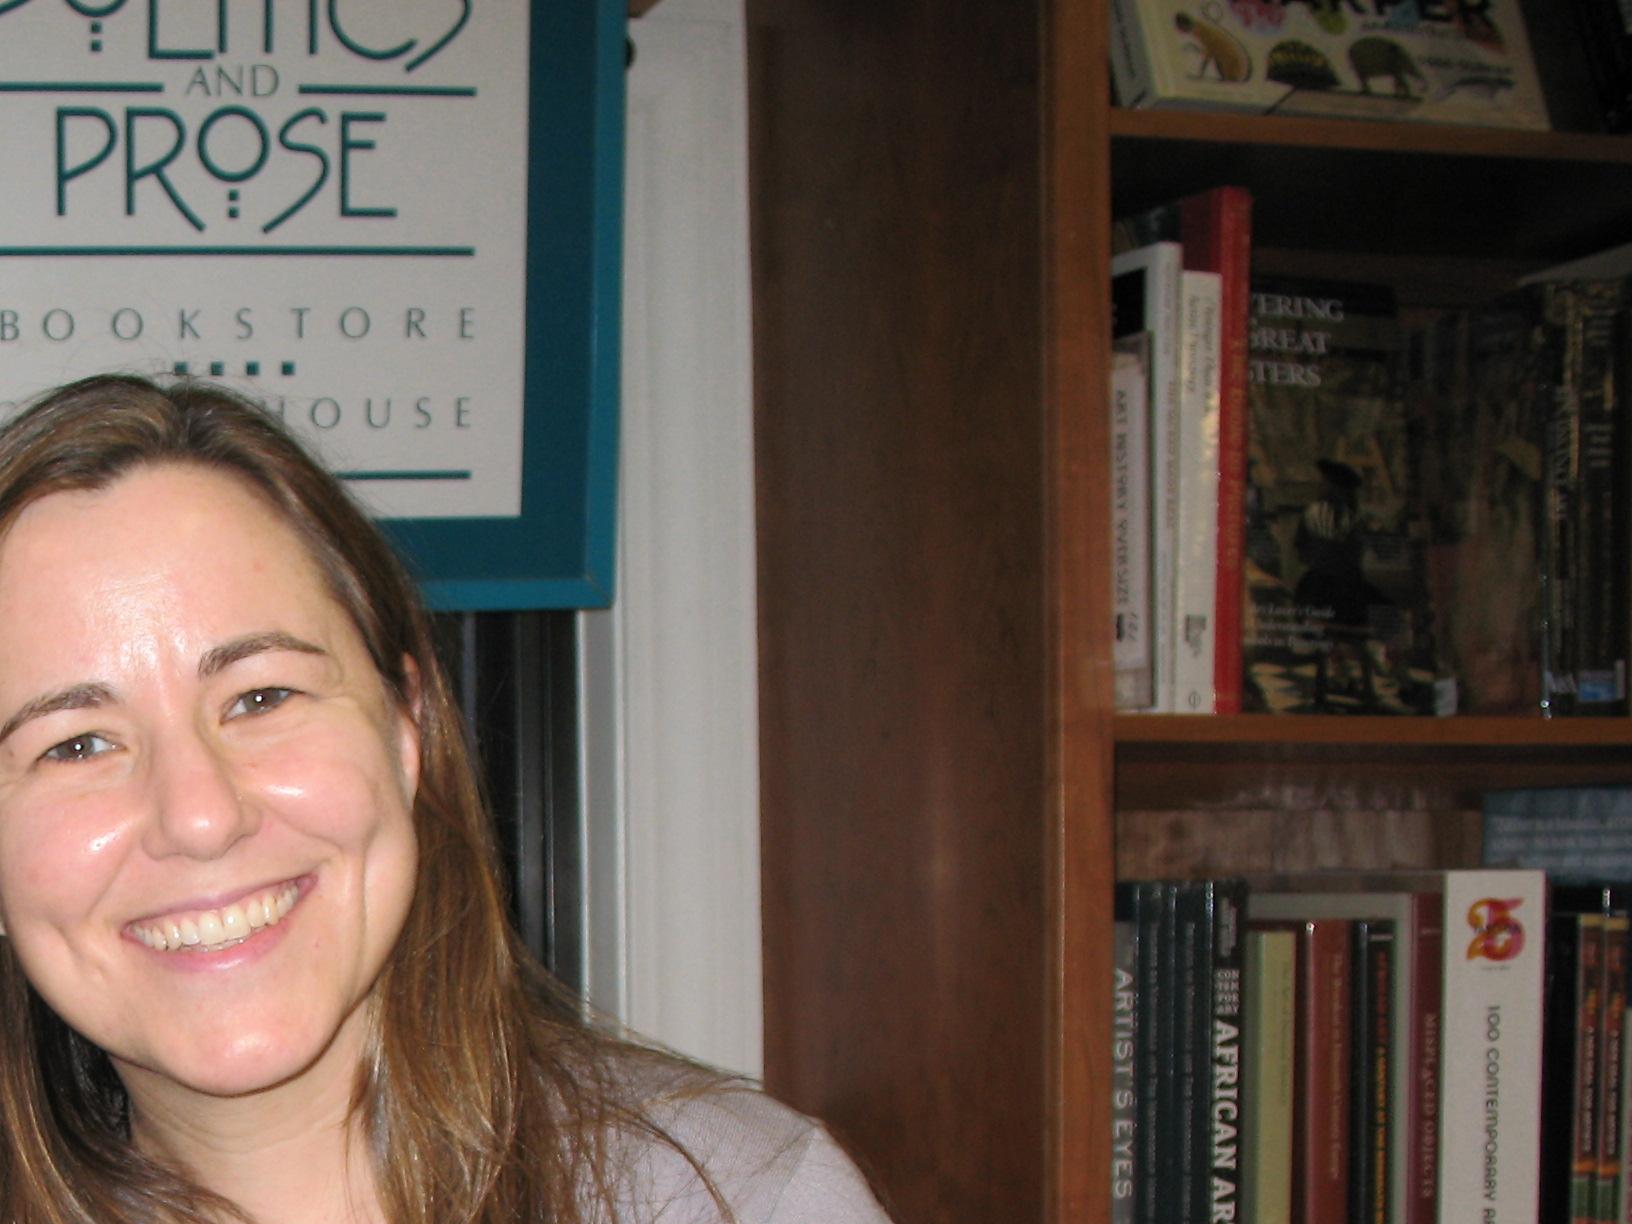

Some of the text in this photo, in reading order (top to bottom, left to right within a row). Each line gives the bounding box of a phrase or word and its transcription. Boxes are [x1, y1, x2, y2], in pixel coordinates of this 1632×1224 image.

[184, 63, 280, 99] AND
[56, 105, 399, 234] PROSE
[1112, 967, 1135, 1199] ARTIST'S EYES
[1486, 1005, 1501, 1042] 100
[1211, 1018, 1241, 1171] AFRICAN
[1421, 1012, 1437, 1198] MISPLACED OBJECTS
